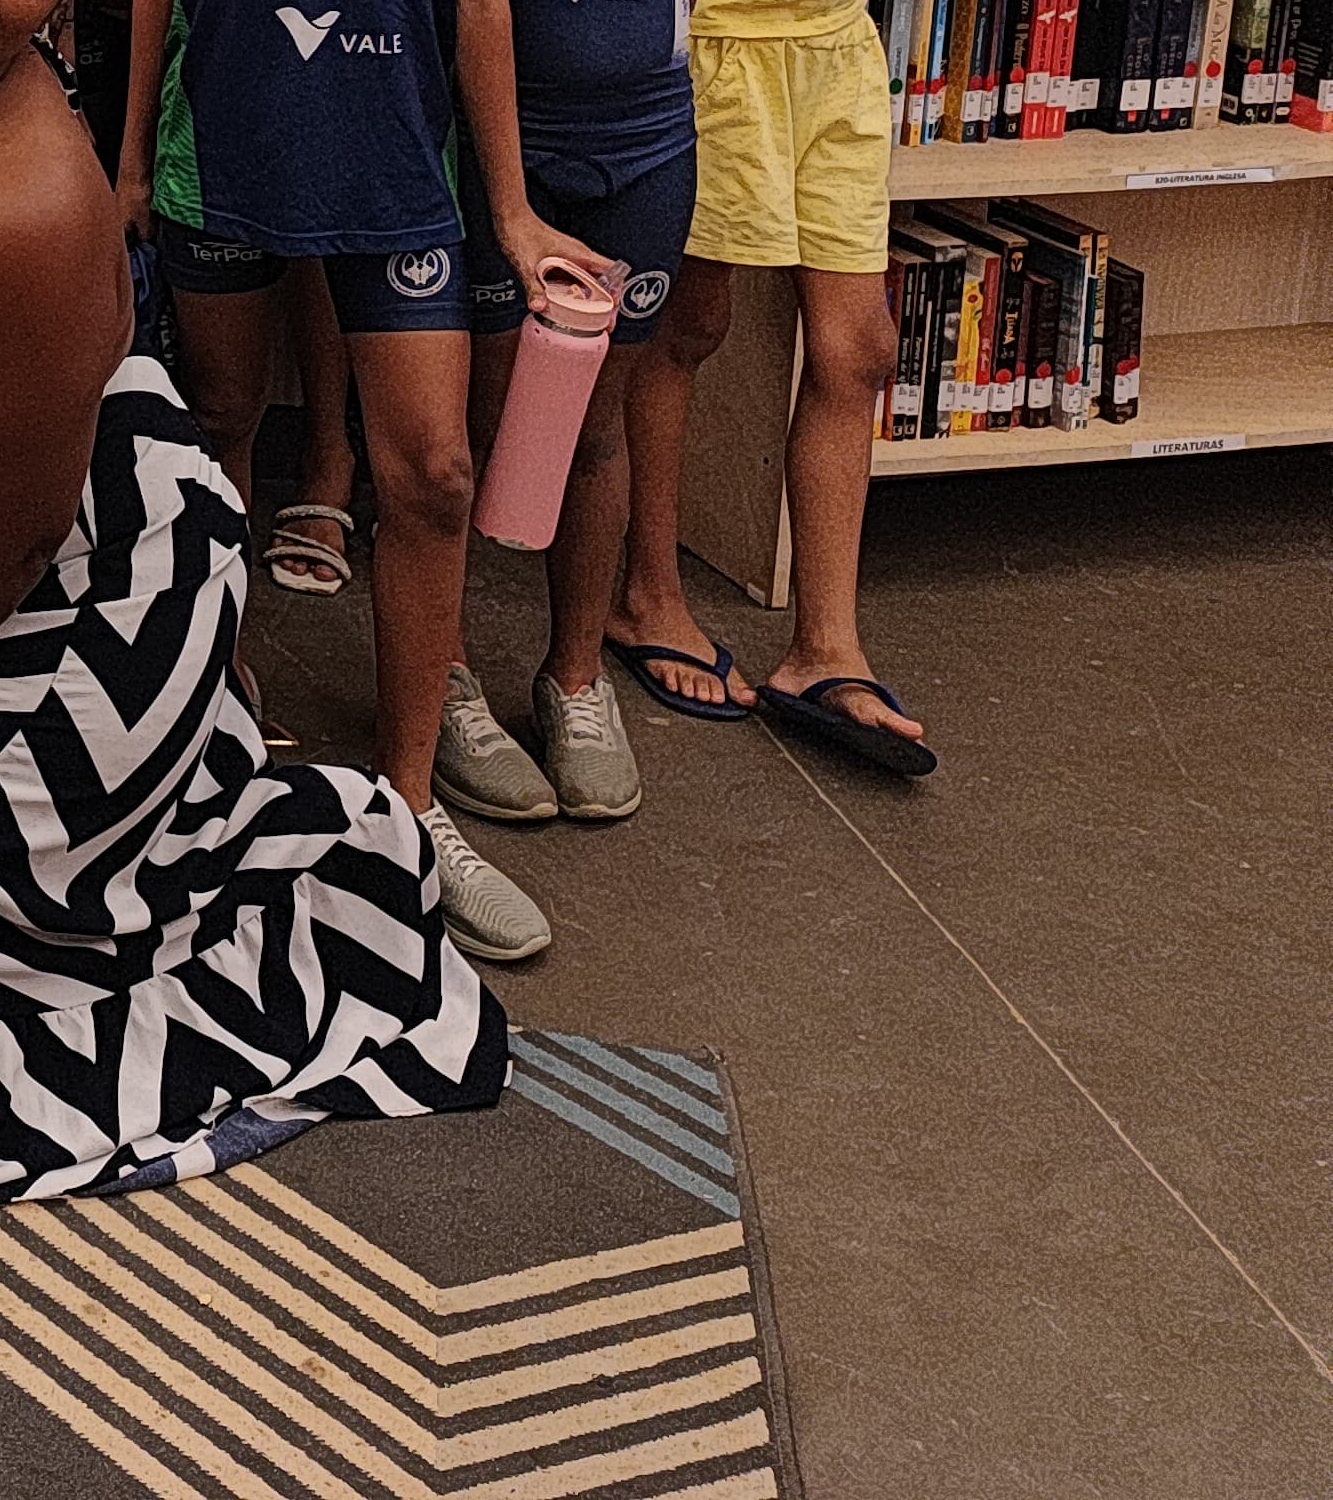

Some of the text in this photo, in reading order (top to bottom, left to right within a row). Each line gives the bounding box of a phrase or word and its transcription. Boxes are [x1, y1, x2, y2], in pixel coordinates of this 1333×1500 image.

[340, 33, 403, 55] VALE
[1216, 172, 1247, 181] INGLESA
[189, 243, 263, 264] TerPaz
[1152, 439, 1224, 454] LITERATURAS
